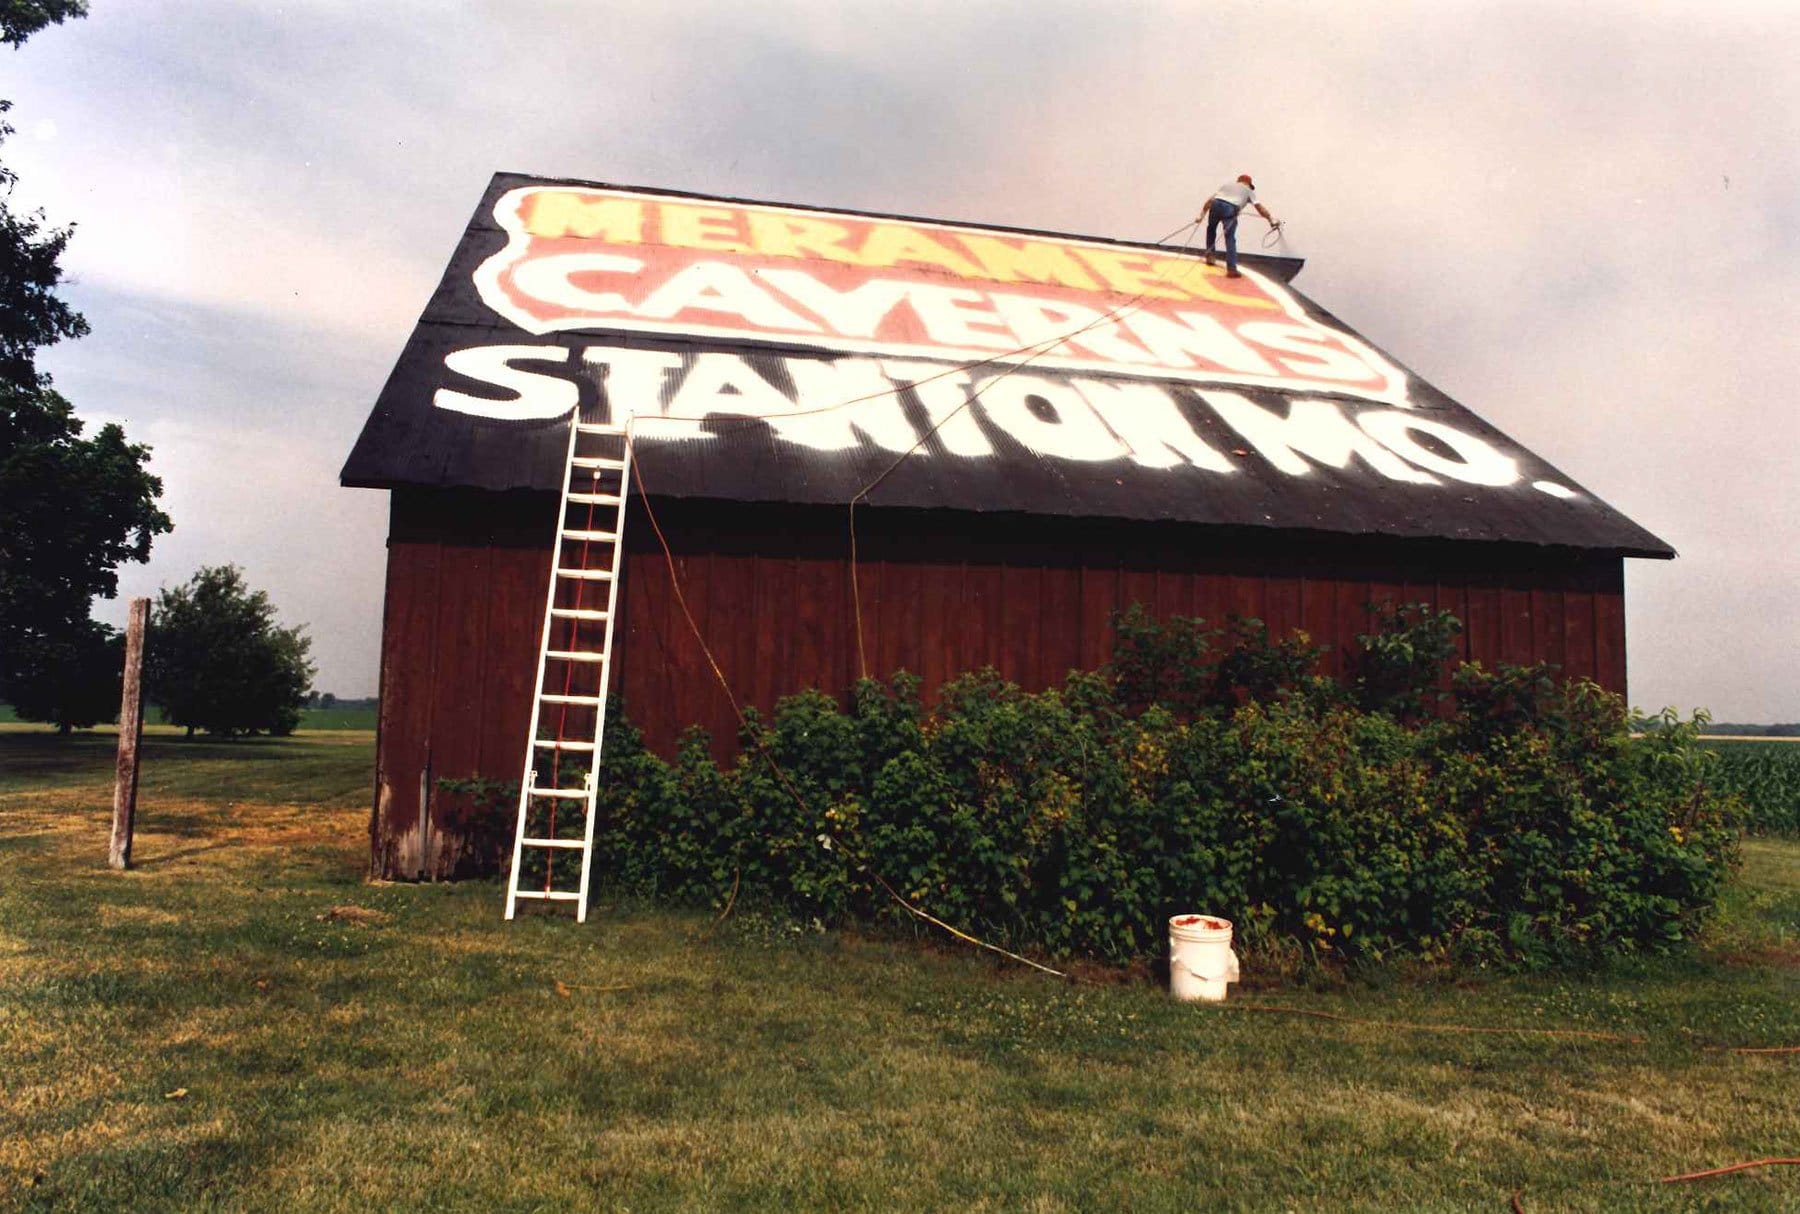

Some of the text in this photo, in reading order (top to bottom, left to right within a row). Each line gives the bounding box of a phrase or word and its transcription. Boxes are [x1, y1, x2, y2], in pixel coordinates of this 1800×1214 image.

[525, 190, 1282, 309] MERAMEC
[513, 252, 1388, 382] CAVERNS
[433, 344, 1581, 499] STANTON MO.
